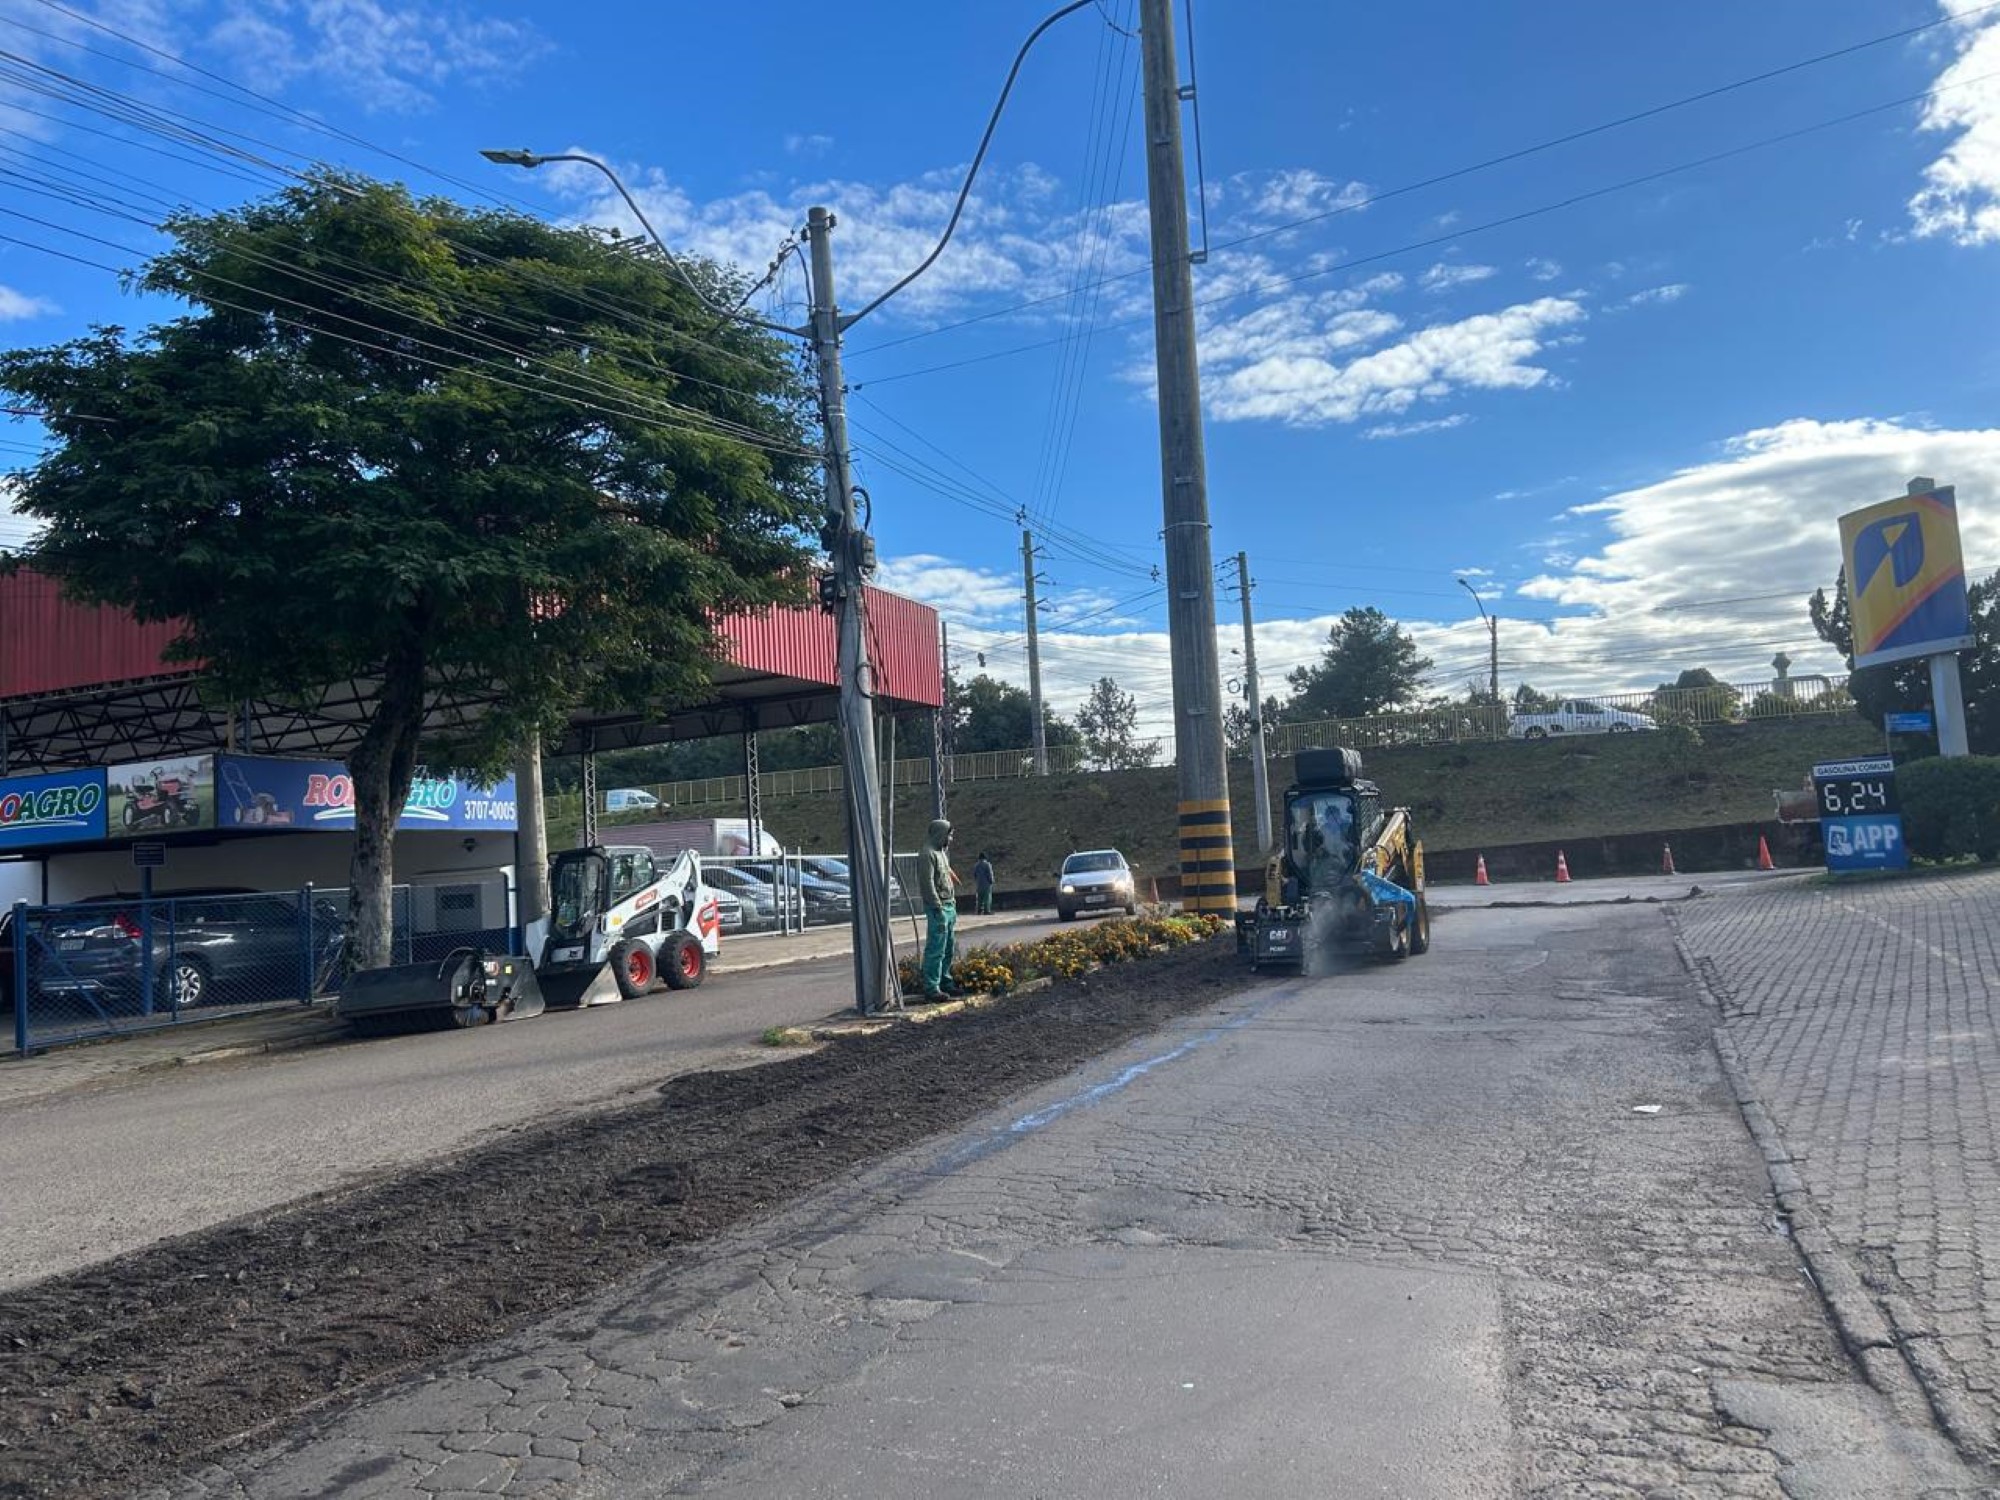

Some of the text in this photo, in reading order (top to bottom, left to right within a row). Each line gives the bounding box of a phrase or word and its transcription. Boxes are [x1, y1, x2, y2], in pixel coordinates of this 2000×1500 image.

[303, 775, 457, 808] ROGRO
[1824, 781, 1886, 815] 6,24
[464, 800, 516, 820] 3707-0005
[1854, 824, 1899, 850] APP
